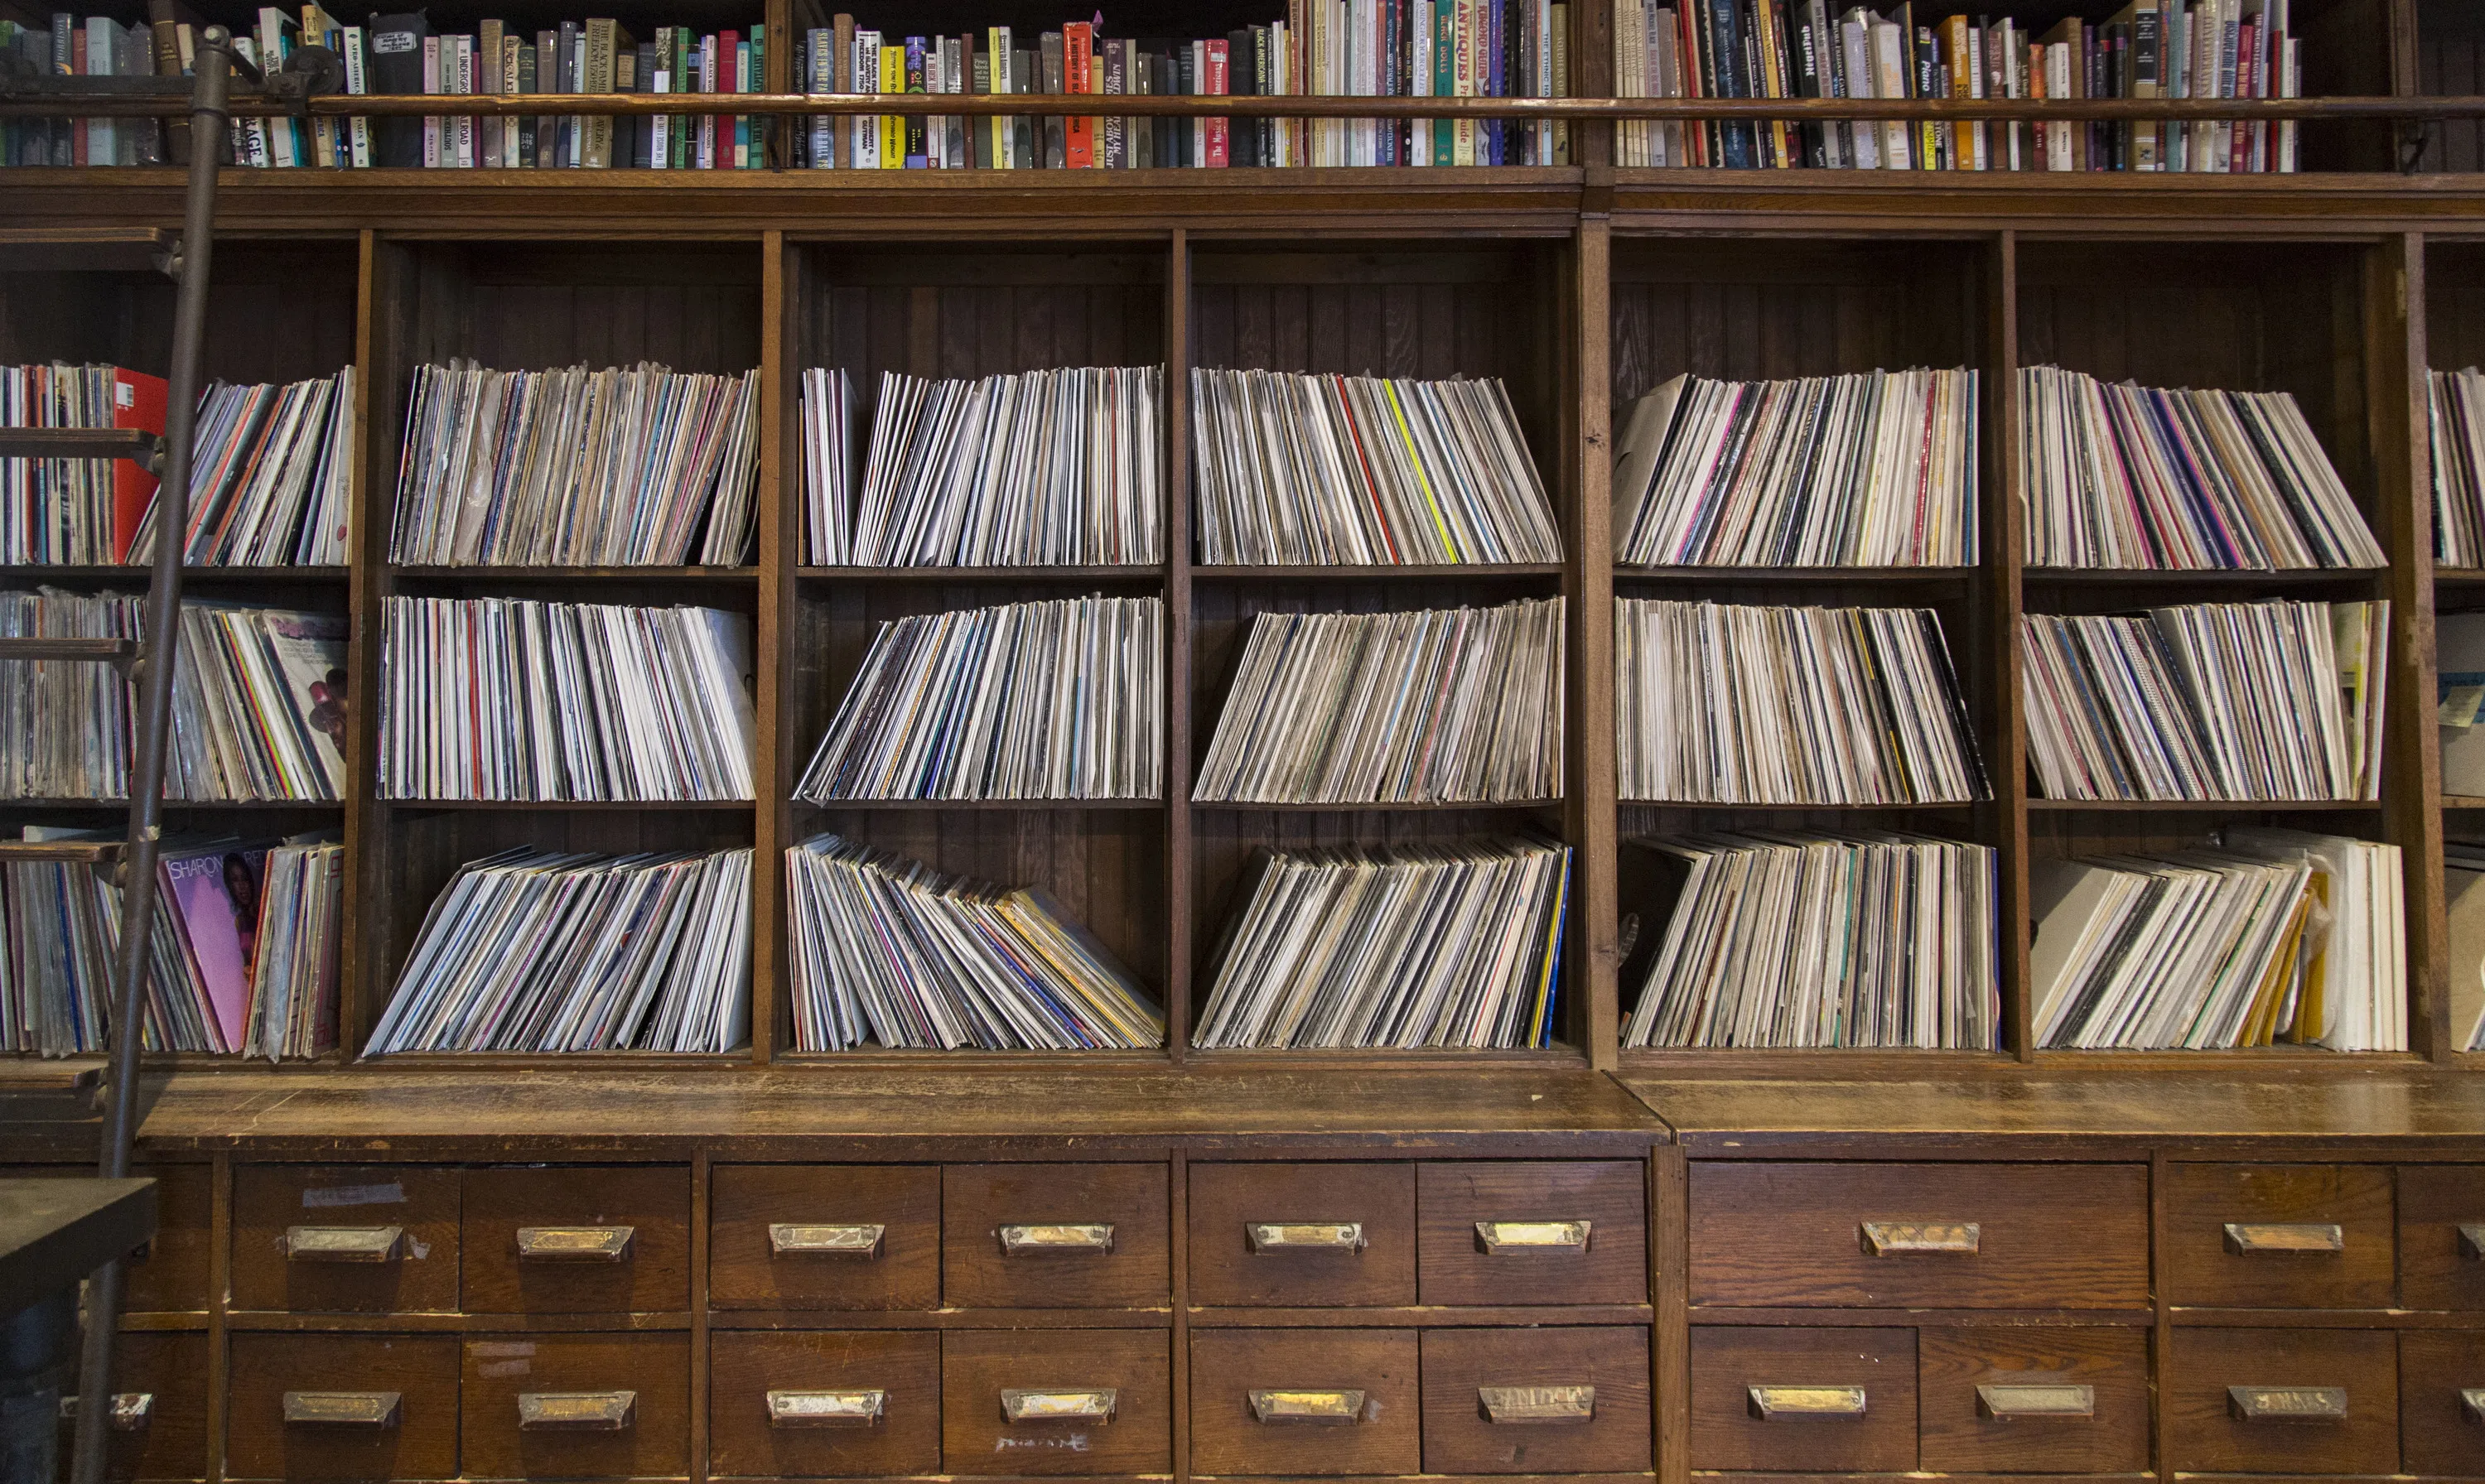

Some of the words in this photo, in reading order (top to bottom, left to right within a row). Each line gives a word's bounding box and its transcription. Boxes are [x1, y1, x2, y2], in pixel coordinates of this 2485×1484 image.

[601, 25, 609, 41] THE
[1257, 29, 1266, 47] BLACK
[1477, 5, 1488, 47] RECORD
[818, 32, 828, 57] SLAVES
[1456, 2, 1469, 81] ANTIQUES
[351, 42, 359, 93] AFRO-AMERICA
[600, 43, 608, 68] BLACK
[1257, 49, 1266, 83] AMERICANA
[460, 56, 468, 93] UNDERGRO
[598, 70, 606, 93] FAMIL
[818, 68, 828, 81] THE
[928, 63, 936, 81] BLACK
[1072, 73, 1079, 81] OF
[1779, 66, 1788, 98] AMERICAN
[1921, 60, 1931, 92] Piano
[818, 83, 828, 93] FA
[244, 118, 262, 157] RAGE
[460, 117, 468, 144] AILROAD
[596, 119, 604, 143] AVERY
[818, 116, 828, 138] DWARD
[1105, 117, 1113, 148] ABOV
[1213, 123, 1222, 142] Music
[818, 140, 828, 157] BALL
[1113, 143, 1121, 155] MY
[1213, 146, 1222, 157] The
[171, 855, 224, 879] SHARON
